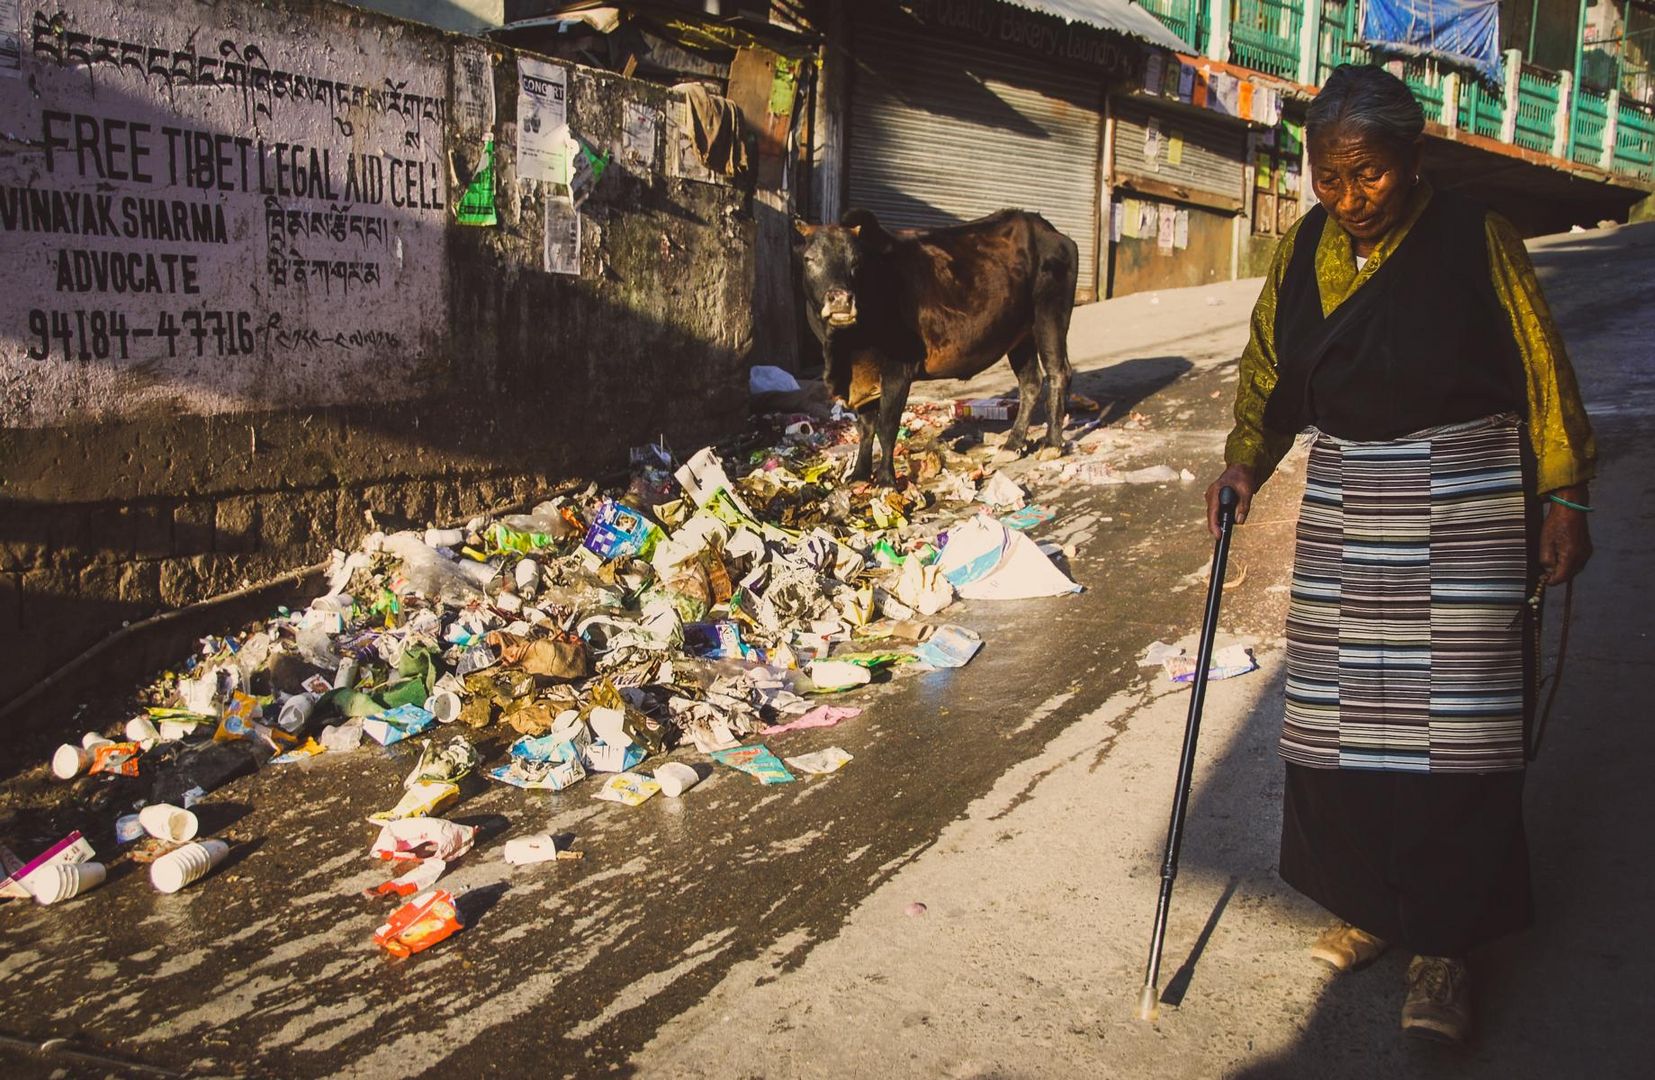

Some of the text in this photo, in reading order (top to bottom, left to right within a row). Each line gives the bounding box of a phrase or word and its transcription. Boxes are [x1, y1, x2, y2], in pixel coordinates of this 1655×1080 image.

[523, 78, 564, 100] CONCRT
[42, 110, 444, 210] FREE TIBET LEGAL AID CELL
[0, 184, 229, 245] VINAYAK SHARMA
[55, 249, 200, 295] ADVOCATE
